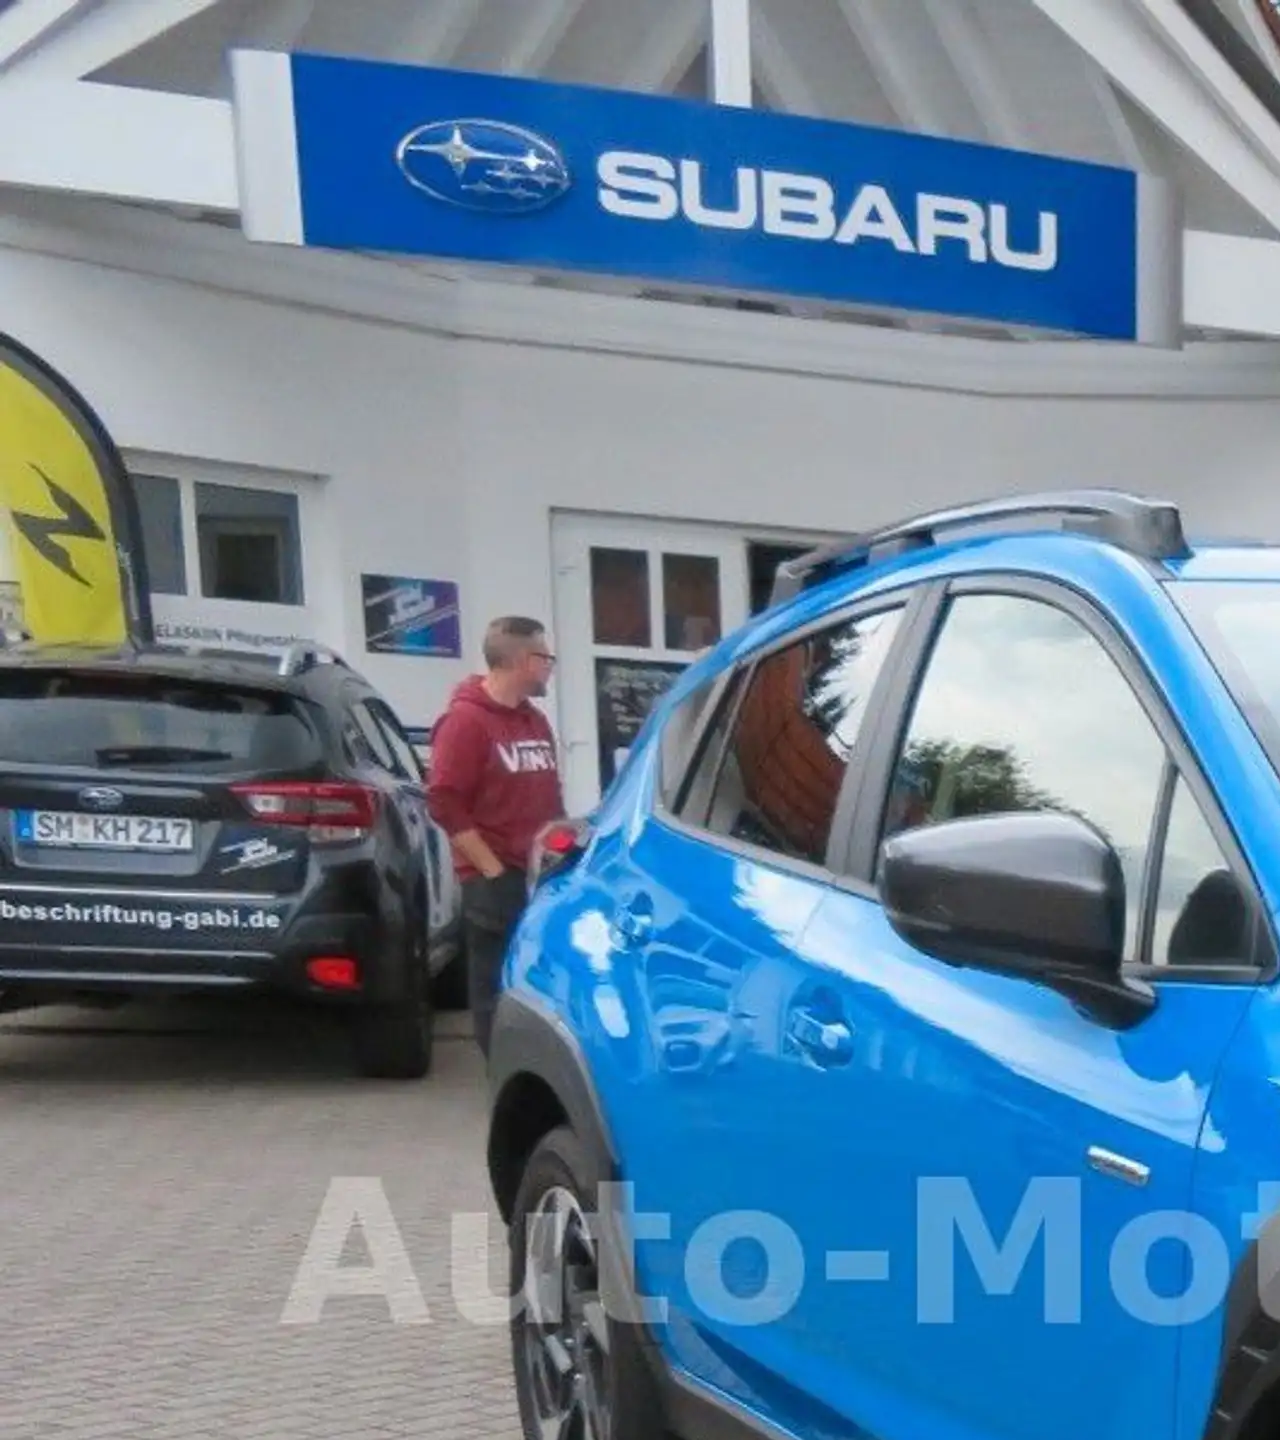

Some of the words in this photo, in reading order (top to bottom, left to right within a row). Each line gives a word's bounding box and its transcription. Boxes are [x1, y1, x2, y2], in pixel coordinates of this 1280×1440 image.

[597, 151, 1058, 272] SUBARU
[36, 814, 74, 838] SM
[92, 818, 131, 841] KH
[137, 821, 191, 844] 217
[1, 901, 281, 930] beschriftung-gabi.de
